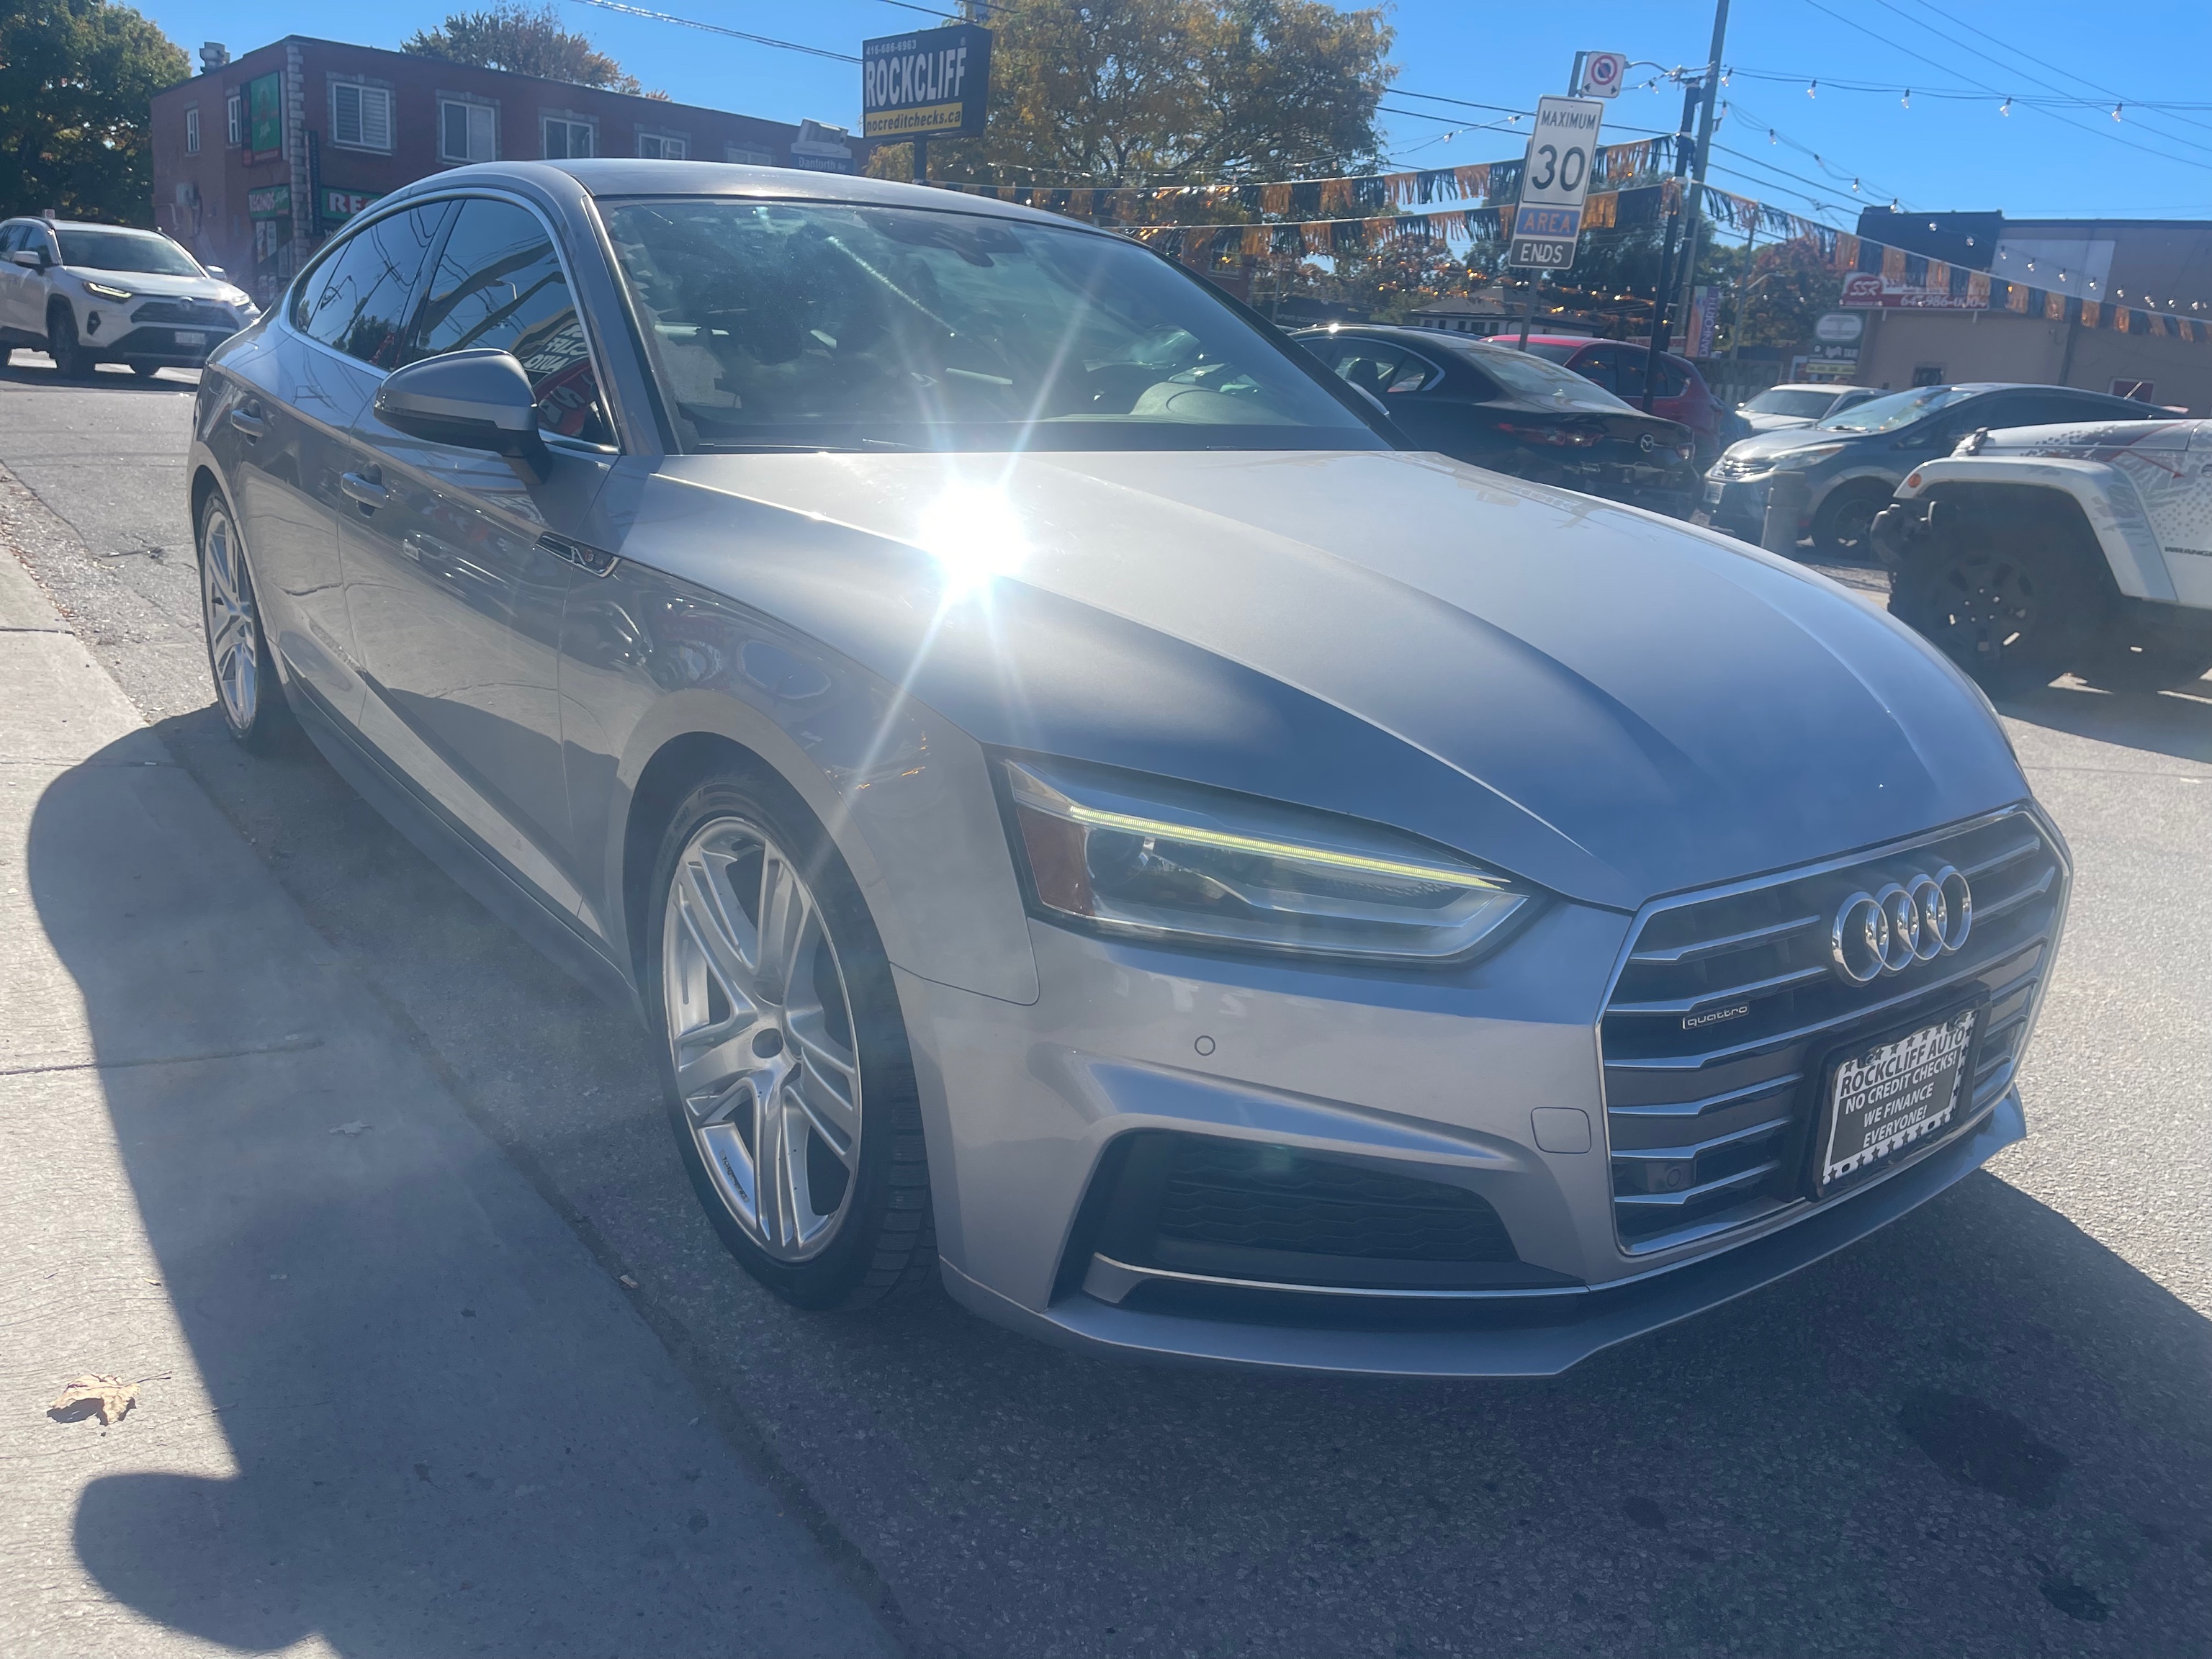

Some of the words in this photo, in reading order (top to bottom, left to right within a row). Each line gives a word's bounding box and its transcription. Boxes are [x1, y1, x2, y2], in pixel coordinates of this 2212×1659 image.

[866, 47, 967, 108] ROCKCLIFF
[866, 109, 961, 132] nocreditchecks.ca
[1541, 110, 1596, 130] MAXIMUM
[799, 156, 836, 170] Danforth
[1532, 144, 1586, 192] 30
[1524, 210, 1571, 233] AREA
[1520, 243, 1564, 264] ENDS
[1850, 279, 1881, 296] SSR
[1699, 297, 1717, 357] DANFORTH
[1687, 1006, 1748, 1027] quattro
[1840, 1043, 1926, 1097] ROCKCLIFF
[1927, 1026, 1966, 1060] AUTO
[1845, 1092, 1865, 1115] NO
[1868, 1072, 1912, 1105] CREDIT
[1912, 1047, 1959, 1084] CHECKS!
[1863, 1109, 1883, 1128] WE
[1883, 1082, 1935, 1118] FINANCE
[1863, 1105, 1928, 1149] EVERYONE!
